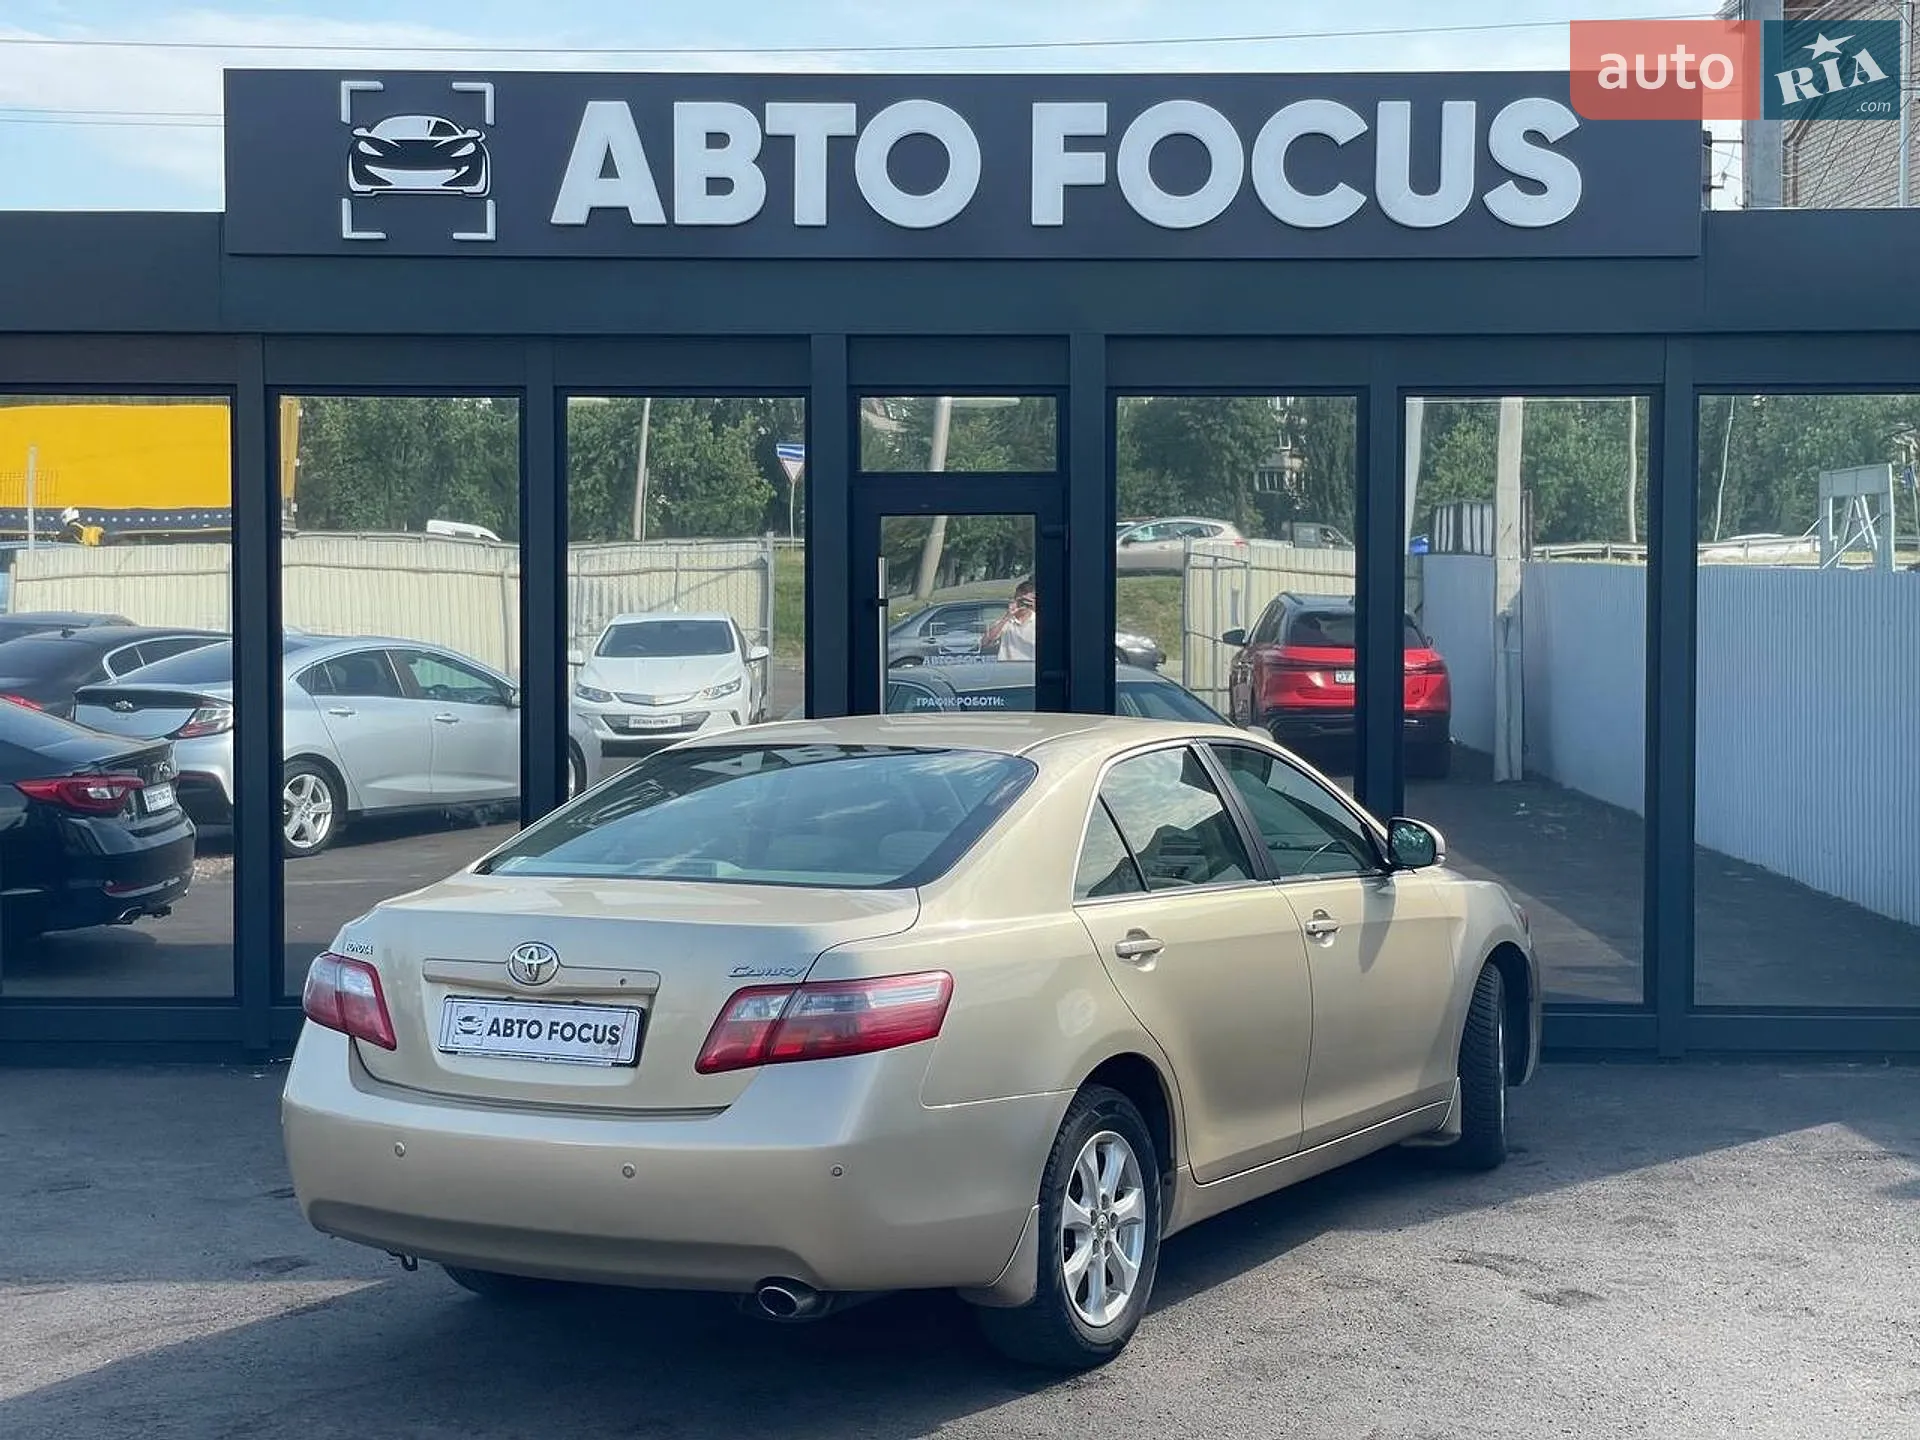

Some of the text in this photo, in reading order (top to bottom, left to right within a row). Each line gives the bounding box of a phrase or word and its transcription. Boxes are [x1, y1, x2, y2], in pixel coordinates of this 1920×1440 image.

[550, 97, 1583, 228] АВТО FOCUS
[486, 1016, 622, 1046] АВТО FOCUS
